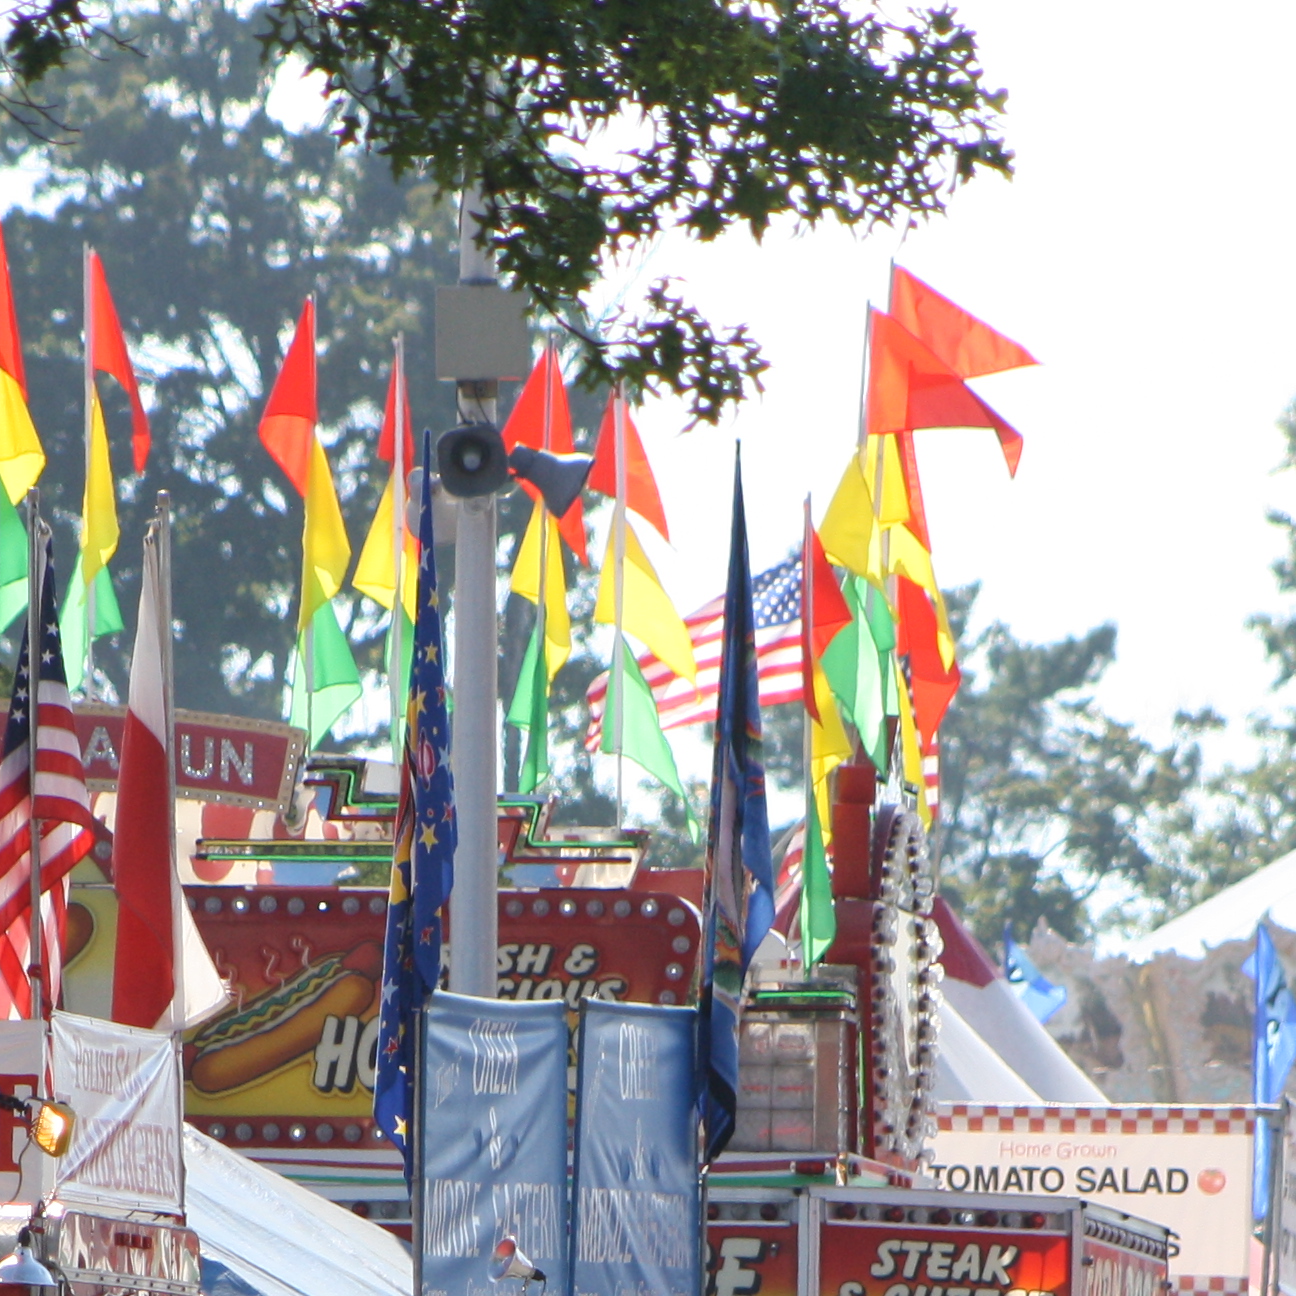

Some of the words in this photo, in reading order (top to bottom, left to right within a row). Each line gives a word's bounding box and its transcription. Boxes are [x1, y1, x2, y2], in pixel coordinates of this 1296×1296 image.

[180, 732, 256, 787] UN
[563, 943, 599, 974] &
[468, 1017, 518, 1095] GREEK
[998, 1139, 1052, 1159] Home
[1056, 1140, 1118, 1160] Grown
[929, 1165, 1066, 1193] TOMATO
[1074, 1166, 1189, 1194] SALAD
[422, 1178, 482, 1258] MIDDLE
[870, 1238, 1018, 1286] STEAK
